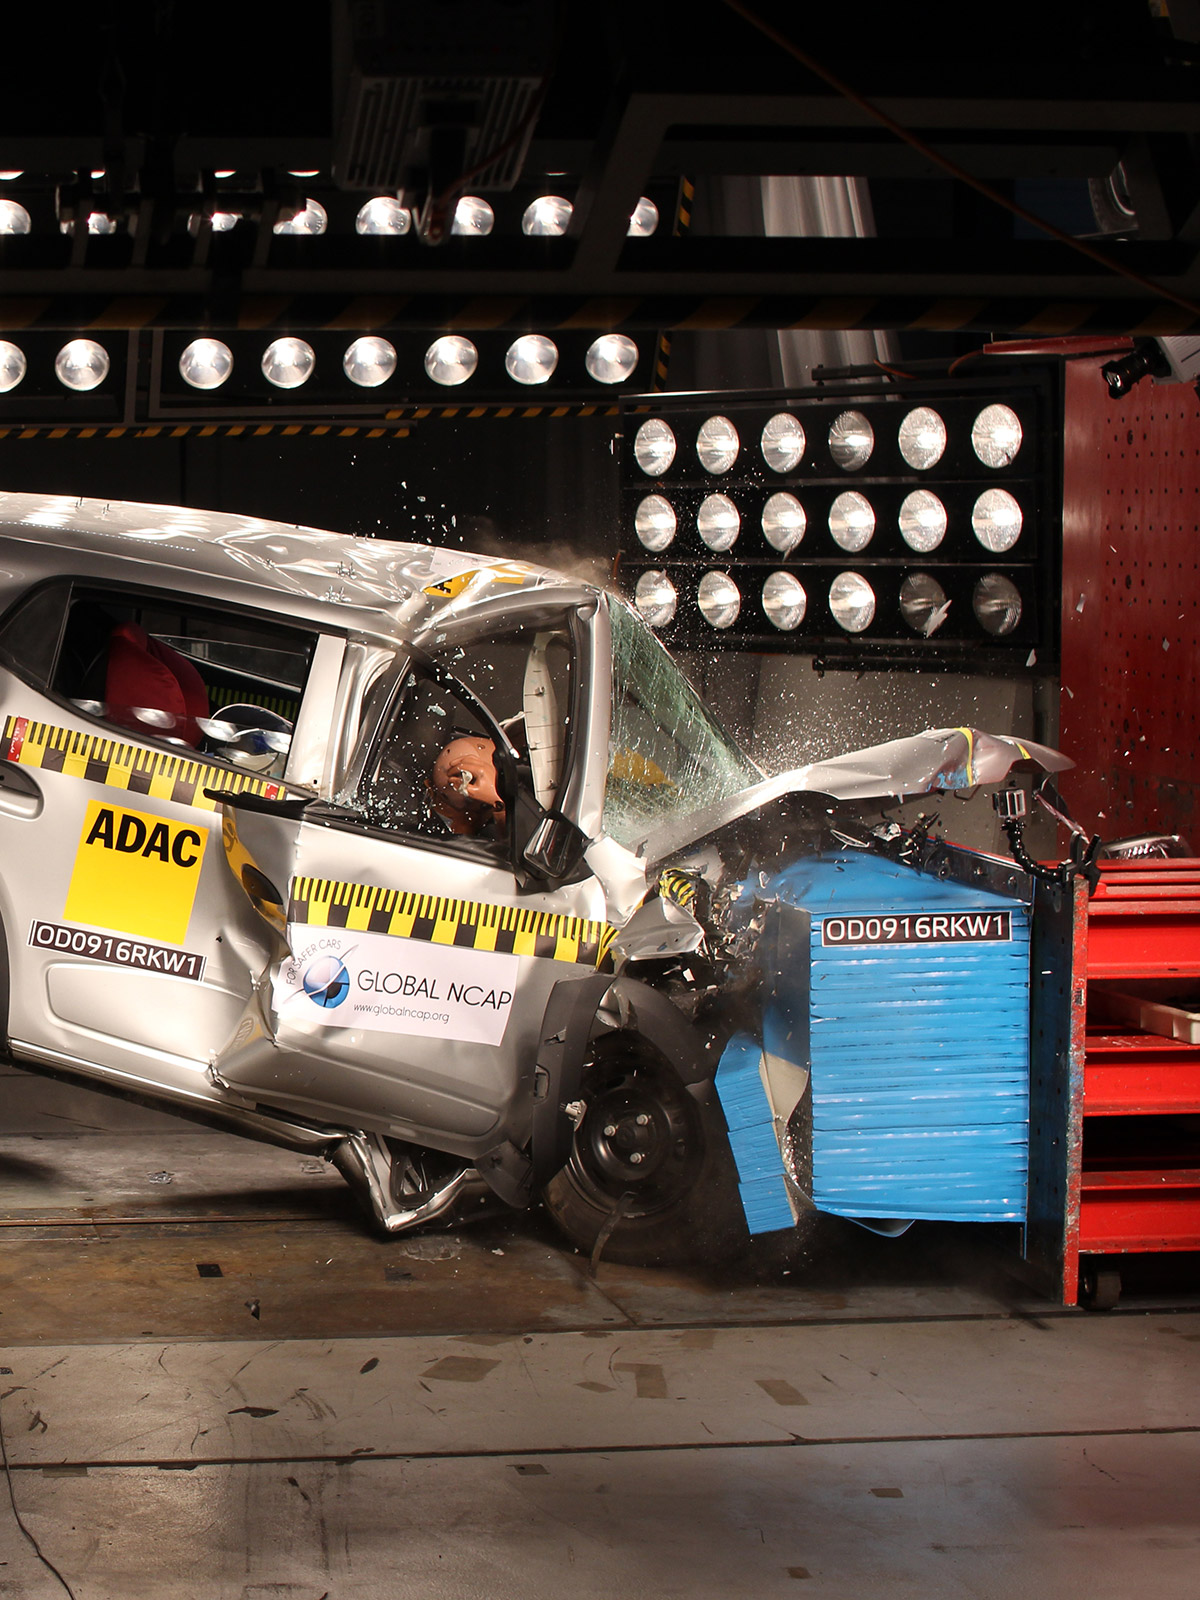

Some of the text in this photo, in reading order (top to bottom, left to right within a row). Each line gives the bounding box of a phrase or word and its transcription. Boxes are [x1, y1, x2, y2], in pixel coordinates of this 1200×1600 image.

[85, 808, 201, 868] ADAC
[826, 914, 1003, 941] OD0916RKW1
[36, 925, 198, 976] OD0916RKW1
[285, 938, 342, 985] FOR SAFER CARS
[357, 969, 512, 1010] GLOBAL NCAP
[353, 1003, 450, 1025] www.globalncap.org
